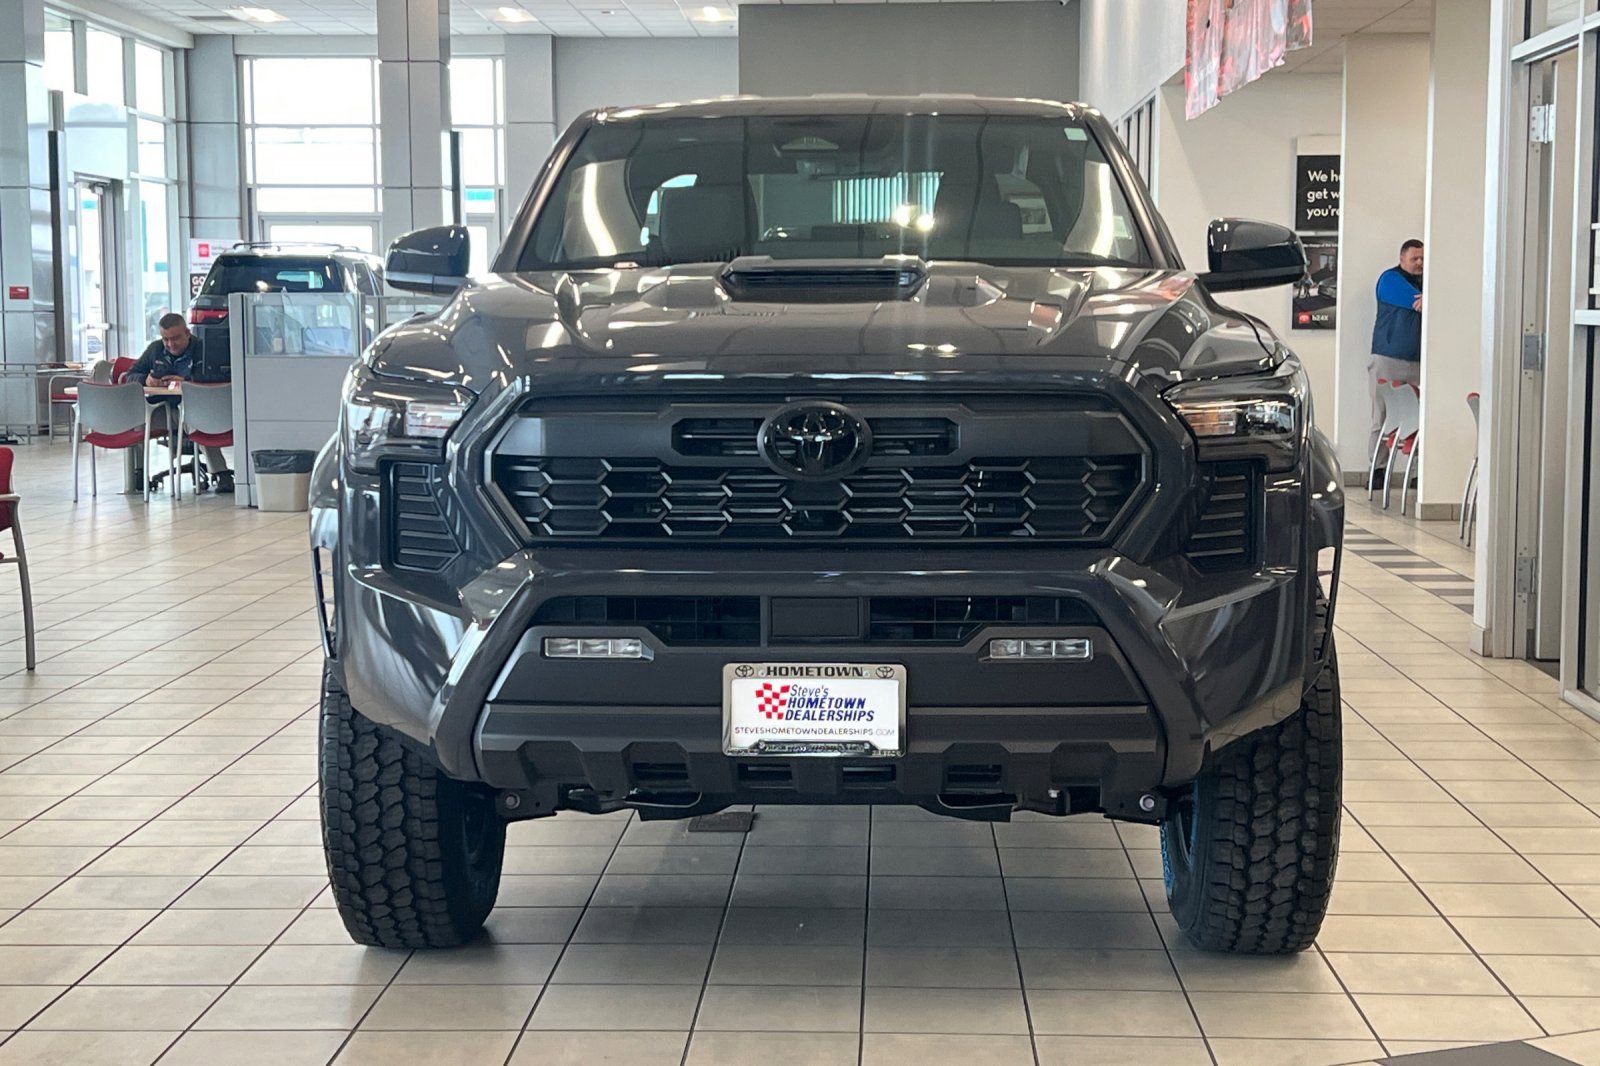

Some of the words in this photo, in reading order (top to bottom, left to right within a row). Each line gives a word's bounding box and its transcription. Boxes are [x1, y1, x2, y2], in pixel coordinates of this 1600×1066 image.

[1308, 170, 1328, 182] We
[1331, 169, 1340, 182] h
[1307, 188, 1328, 203] get
[766, 666, 864, 677] HOMETOWN
[790, 684, 829, 698] Steve's
[787, 698, 867, 709] HOMETOWN
[785, 710, 875, 722] DEALERSHIPS
[735, 727, 895, 736] STEVESHOMETOWNDEALERSHIPS.COM
